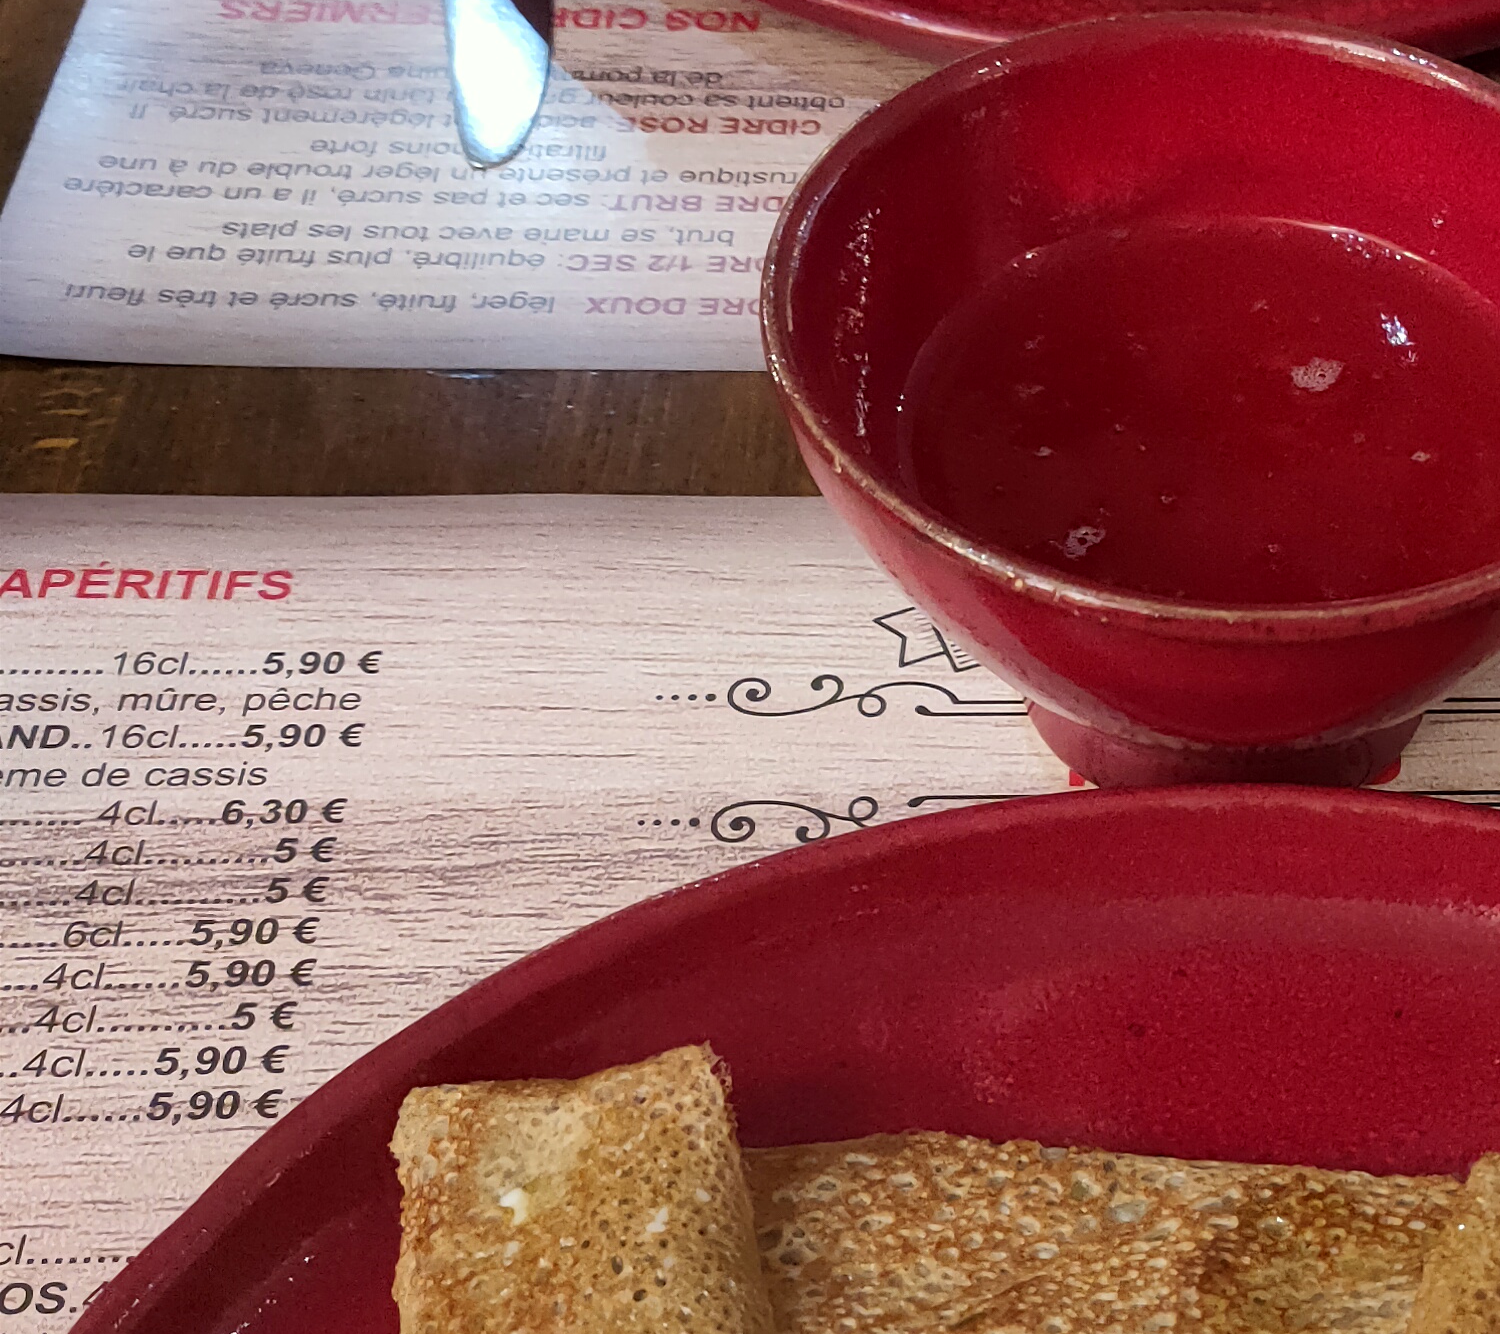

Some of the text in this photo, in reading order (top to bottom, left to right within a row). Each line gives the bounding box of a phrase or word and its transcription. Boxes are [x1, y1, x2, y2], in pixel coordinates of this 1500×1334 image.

[664, 10, 760, 32] NOS
[223, 185, 262, 201] un
[433, 187, 489, 207] pas
[498, 192, 526, 209] et
[534, 192, 591, 209] sec
[221, 219, 735, 246] brut, se marie avec tous les plats
[126, 244, 156, 264] le
[165, 242, 227, 263] que
[236, 247, 316, 268] fruité
[326, 247, 393, 269] plus
[158, 289, 218, 309] très
[228, 290, 258, 308] et
[268, 291, 359, 311] sucré
[471, 290, 554, 315] léger,
[584, 295, 687, 316] DOUX
[0, 561, 293, 600] APÉRITIFS
[113, 650, 384, 679] 16cl 5,90 €
[117, 687, 226, 716] mûre,
[242, 687, 363, 717] pêche
[102, 723, 366, 753] 16cl 5,90 €
[81, 762, 269, 787] de cassis
[98, 797, 349, 828] 4cl 6,30 €
[85, 837, 338, 866] 4cl 5 €
[74, 876, 330, 906] 4cl 5 €
[63, 917, 321, 950] 6cl 5,90 €
[42, 958, 318, 992] 4cl 5,90 €
[34, 1001, 298, 1034] 4cl 5 €
[22, 1045, 290, 1080] 4cl 5,90 €
[0, 1089, 284, 1126] 4cl 5,90 €
